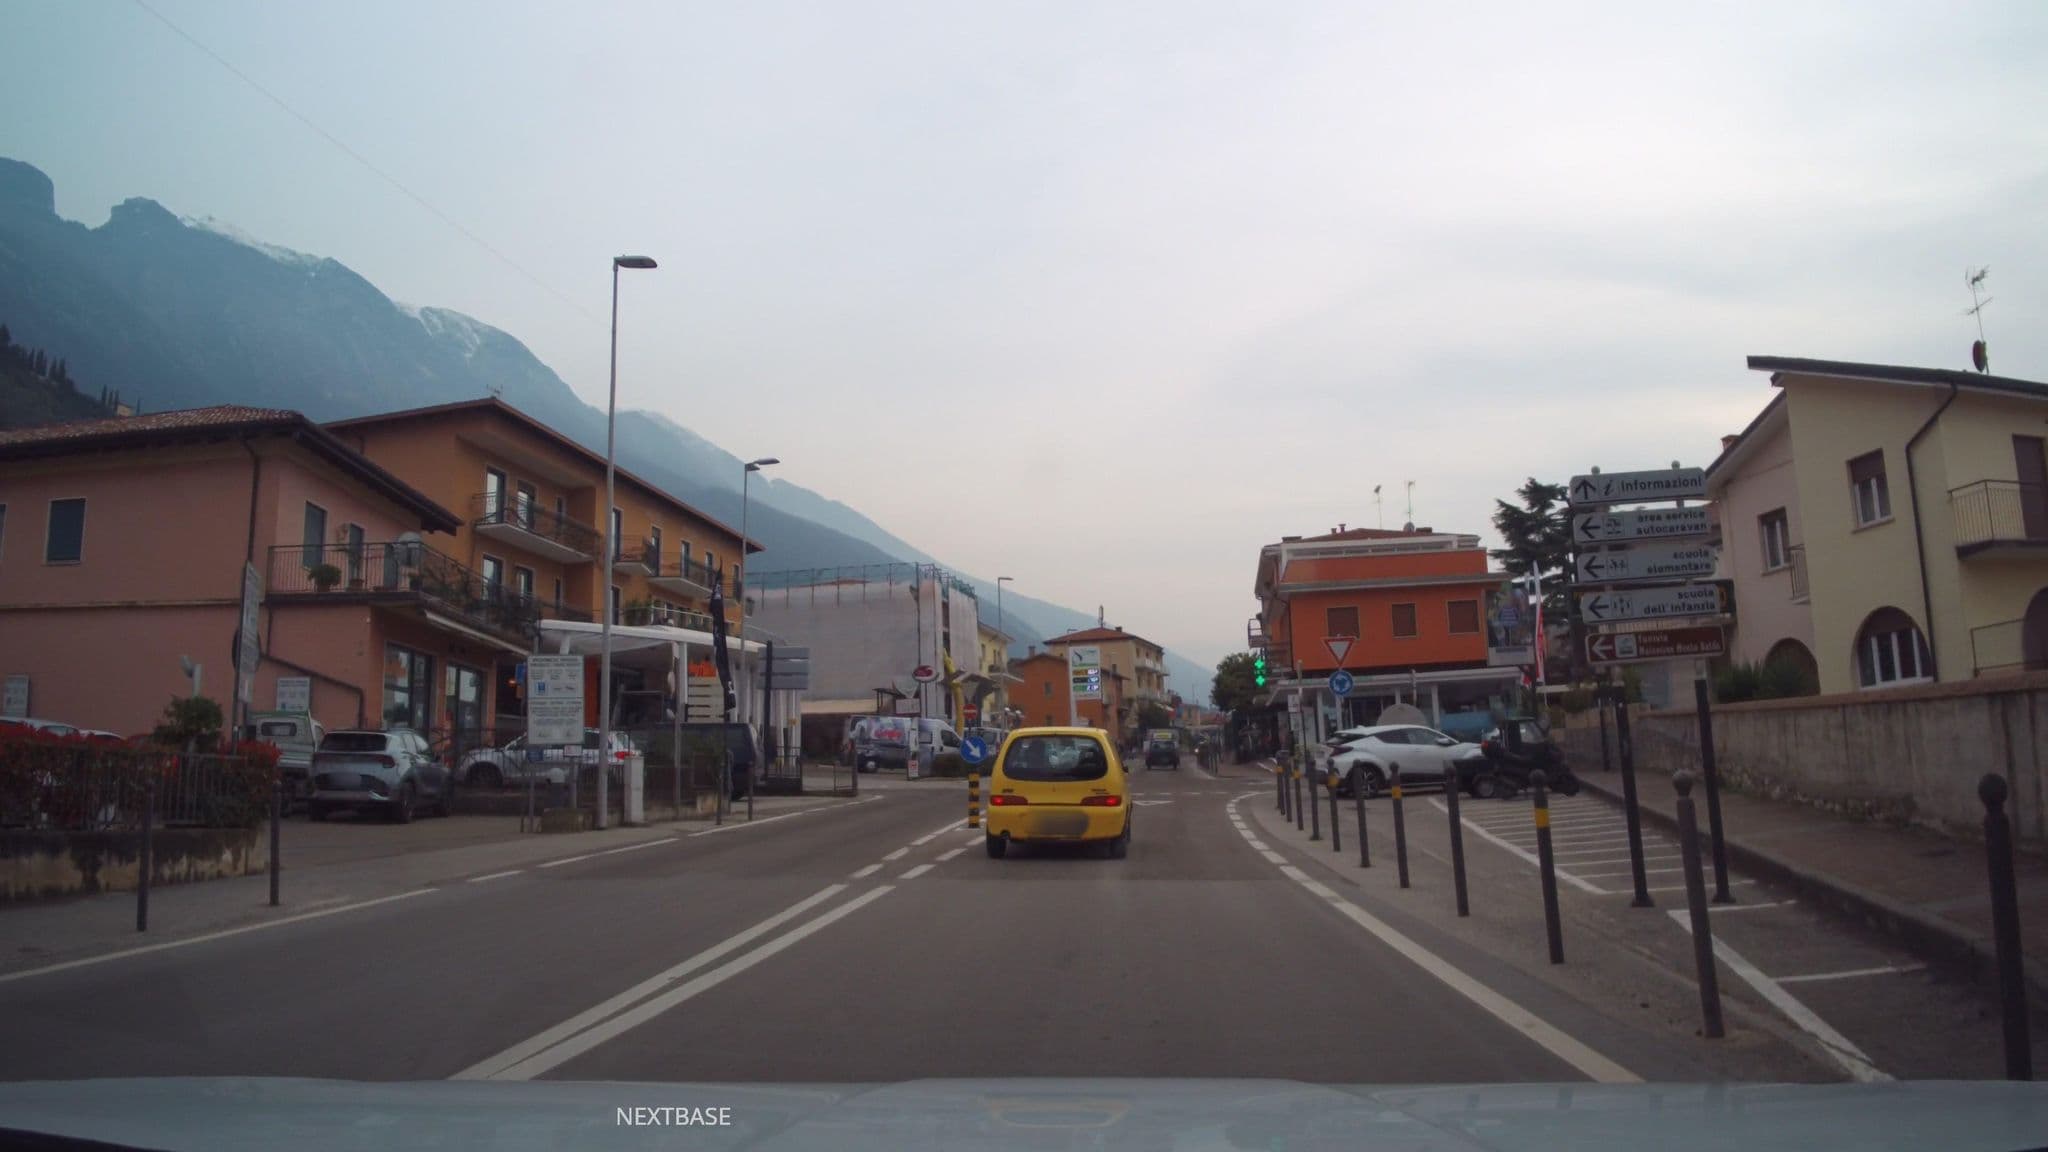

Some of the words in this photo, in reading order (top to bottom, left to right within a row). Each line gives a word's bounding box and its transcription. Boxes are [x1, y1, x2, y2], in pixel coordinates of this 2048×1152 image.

[1620, 476, 1702, 492] informazioni
[1637, 512, 1662, 523] area
[1666, 510, 1705, 521] service
[1636, 522, 1707, 535] autocaravan
[1673, 548, 1710, 559] scuola
[1647, 562, 1712, 574] elementare
[1677, 589, 1715, 600] scuola
